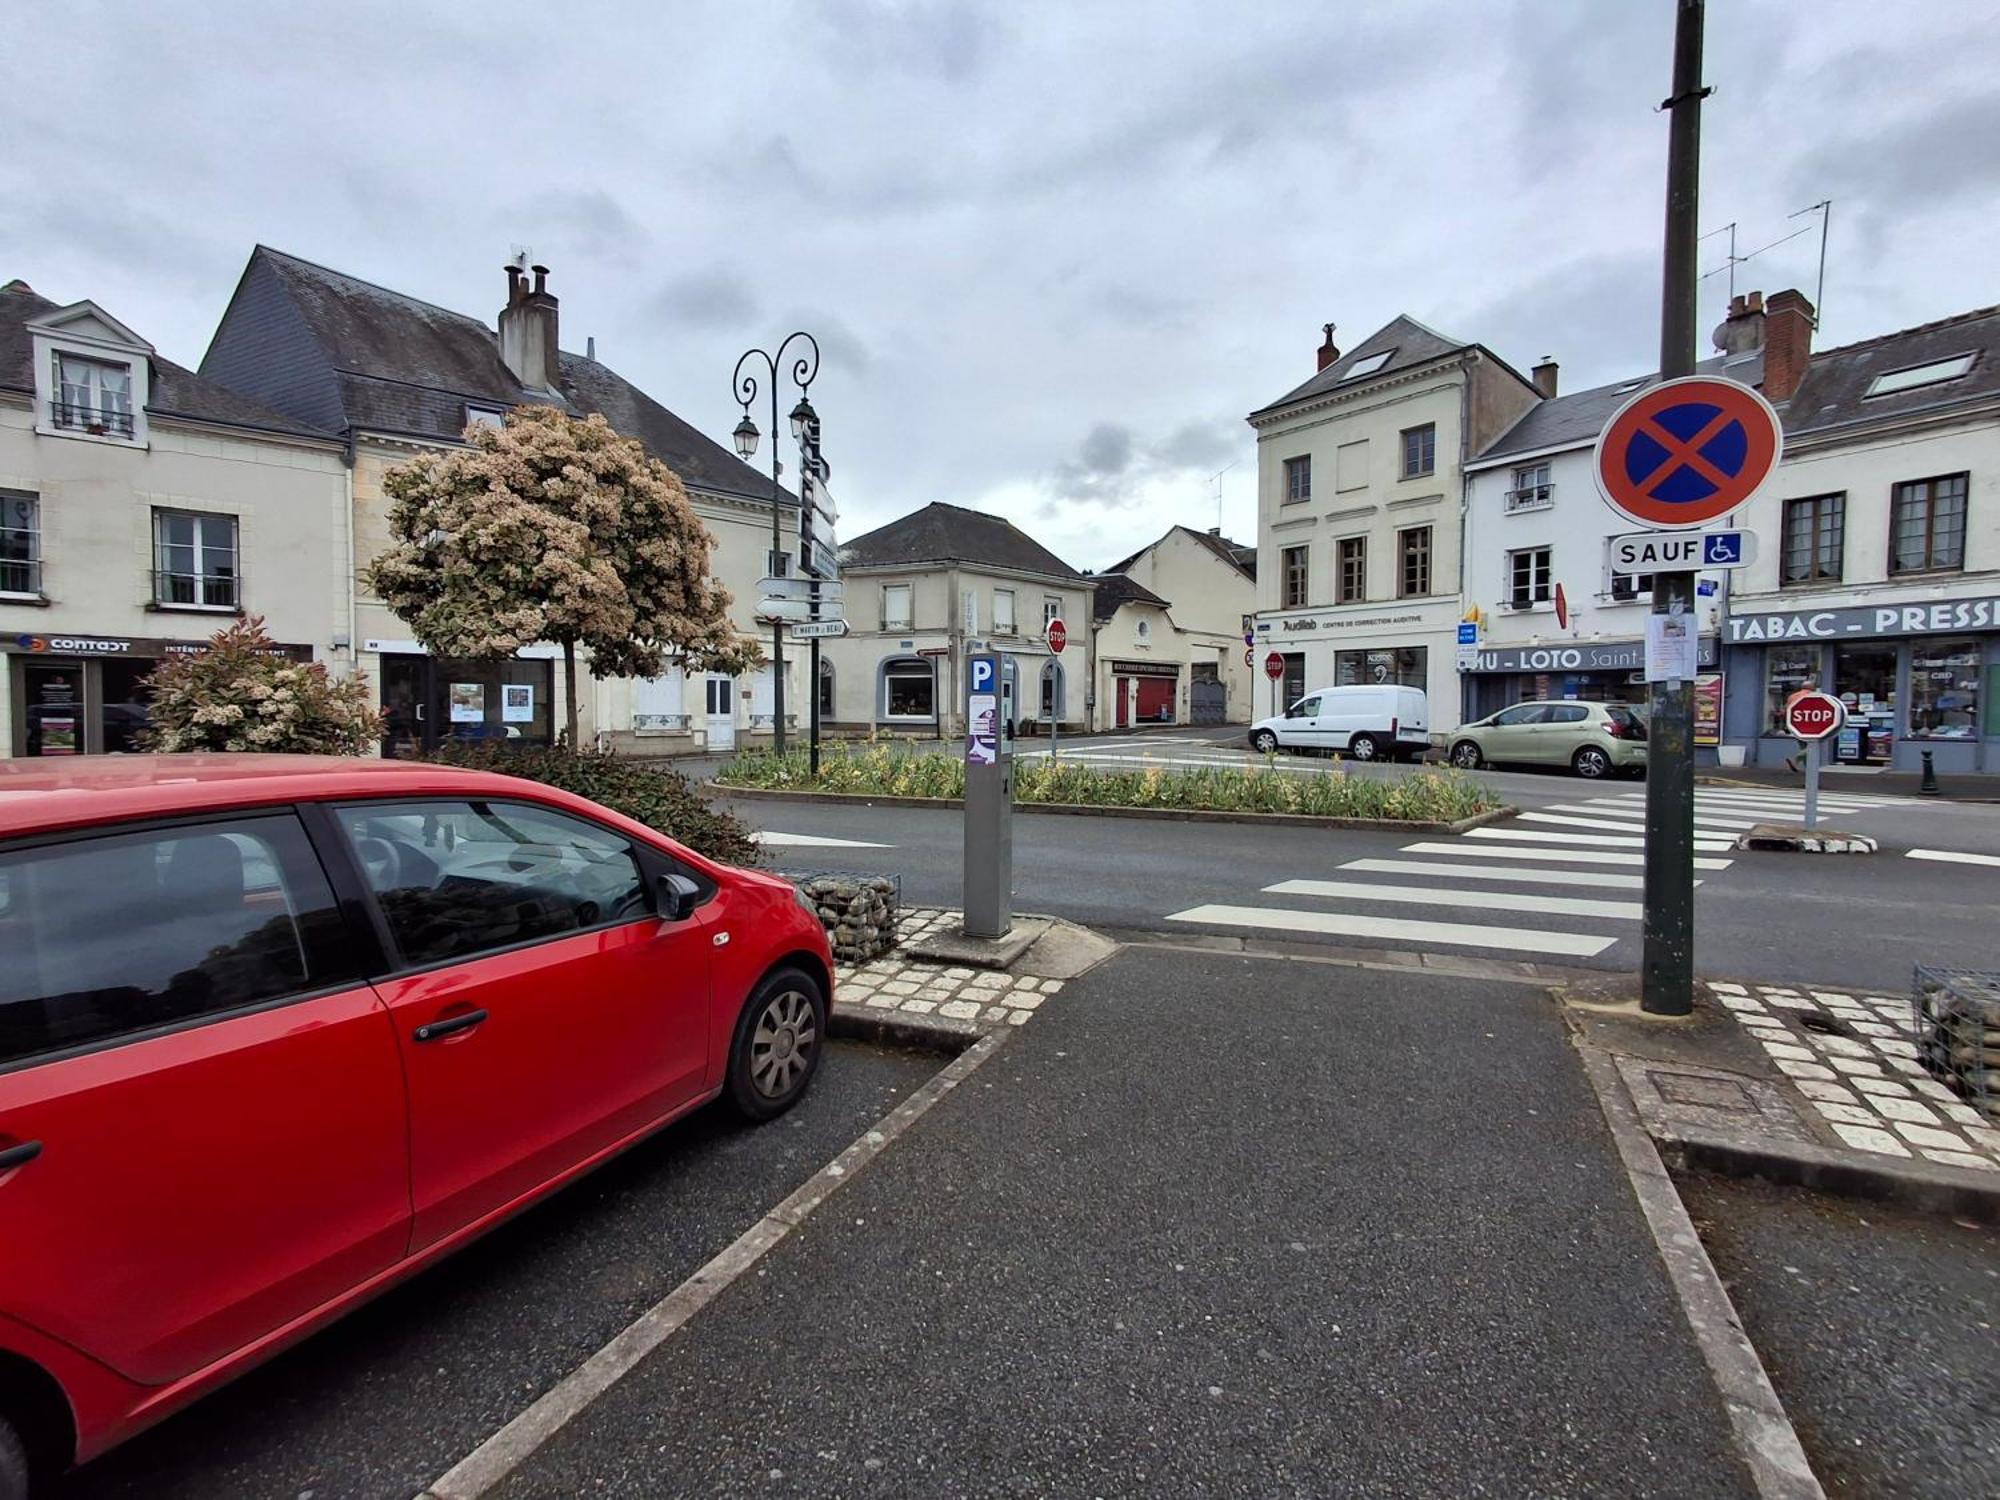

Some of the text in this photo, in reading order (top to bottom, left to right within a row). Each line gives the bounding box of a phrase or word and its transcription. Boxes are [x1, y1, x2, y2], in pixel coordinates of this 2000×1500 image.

[1620, 541, 1698, 563] SAUF
[1050, 631, 1065, 642] STOP
[1729, 613, 1836, 641] TABAC
[1268, 661, 1282, 670] STOP
[1520, 649, 1581, 669] LOTO
[973, 661, 992, 690] P
[1793, 710, 1833, 722] STOP
